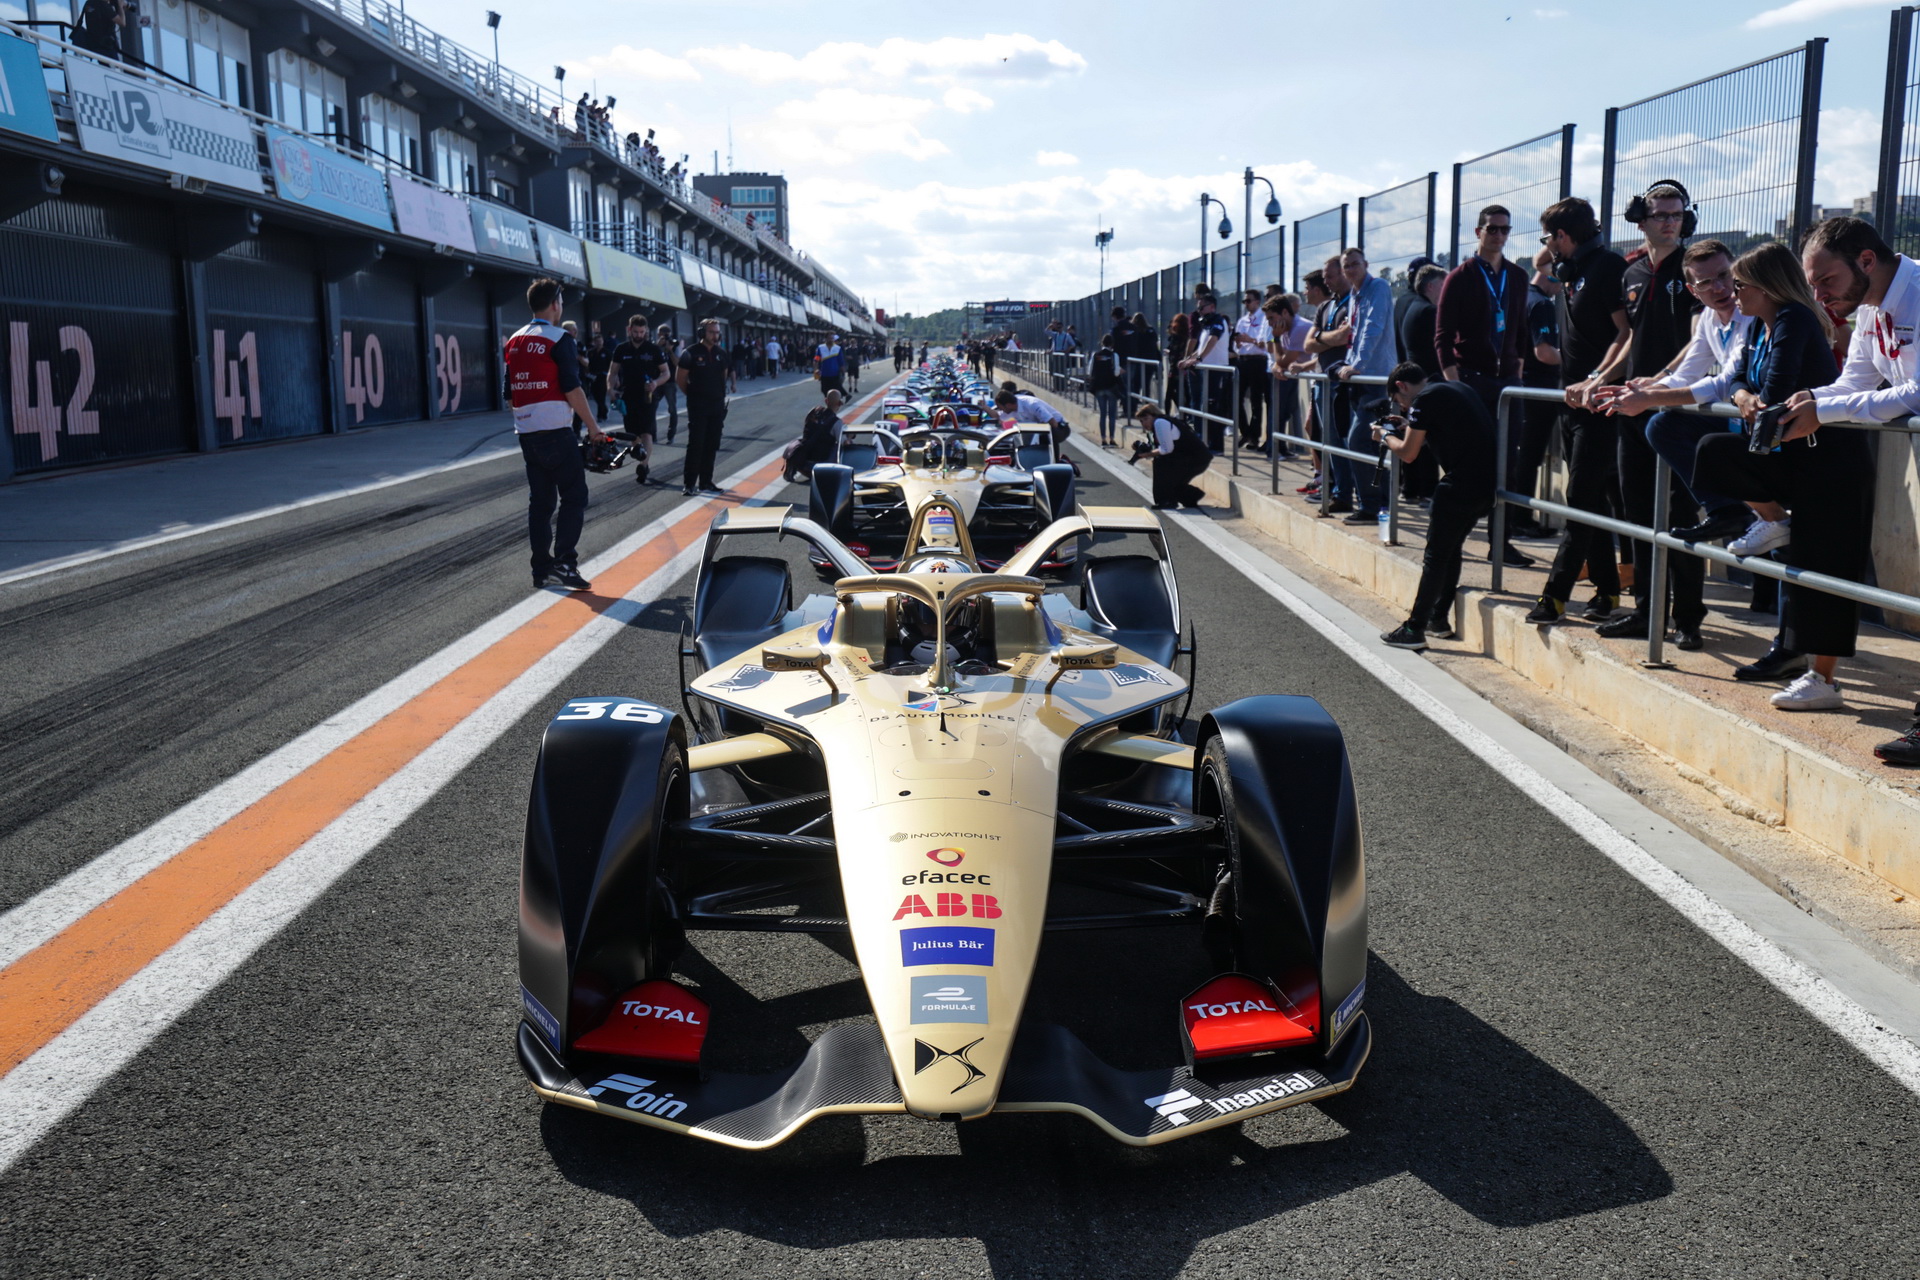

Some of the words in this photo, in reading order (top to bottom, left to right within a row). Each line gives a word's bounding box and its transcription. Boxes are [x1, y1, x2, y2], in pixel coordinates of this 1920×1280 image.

[501, 225, 529, 250] REPSOL
[560, 246, 582, 268] REPSOL
[526, 342, 546, 354] 076
[343, 331, 384, 423] 40
[435, 333, 462, 413] 39
[9, 320, 100, 462] 42
[213, 329, 261, 440] 41
[784, 659, 817, 668] TOTAL
[1064, 657, 1096, 665] TOTAL
[556, 702, 664, 724] 36
[895, 713, 1016, 721] AUTOMOBILES
[902, 870, 991, 885] efacec
[892, 893, 1003, 921] ABB
[912, 940, 954, 951] Julius
[958, 940, 985, 949] Bär
[525, 999, 556, 1038] MICHELIN
[622, 1001, 701, 1025] TOTAL
[1189, 999, 1277, 1018] TOTAL
